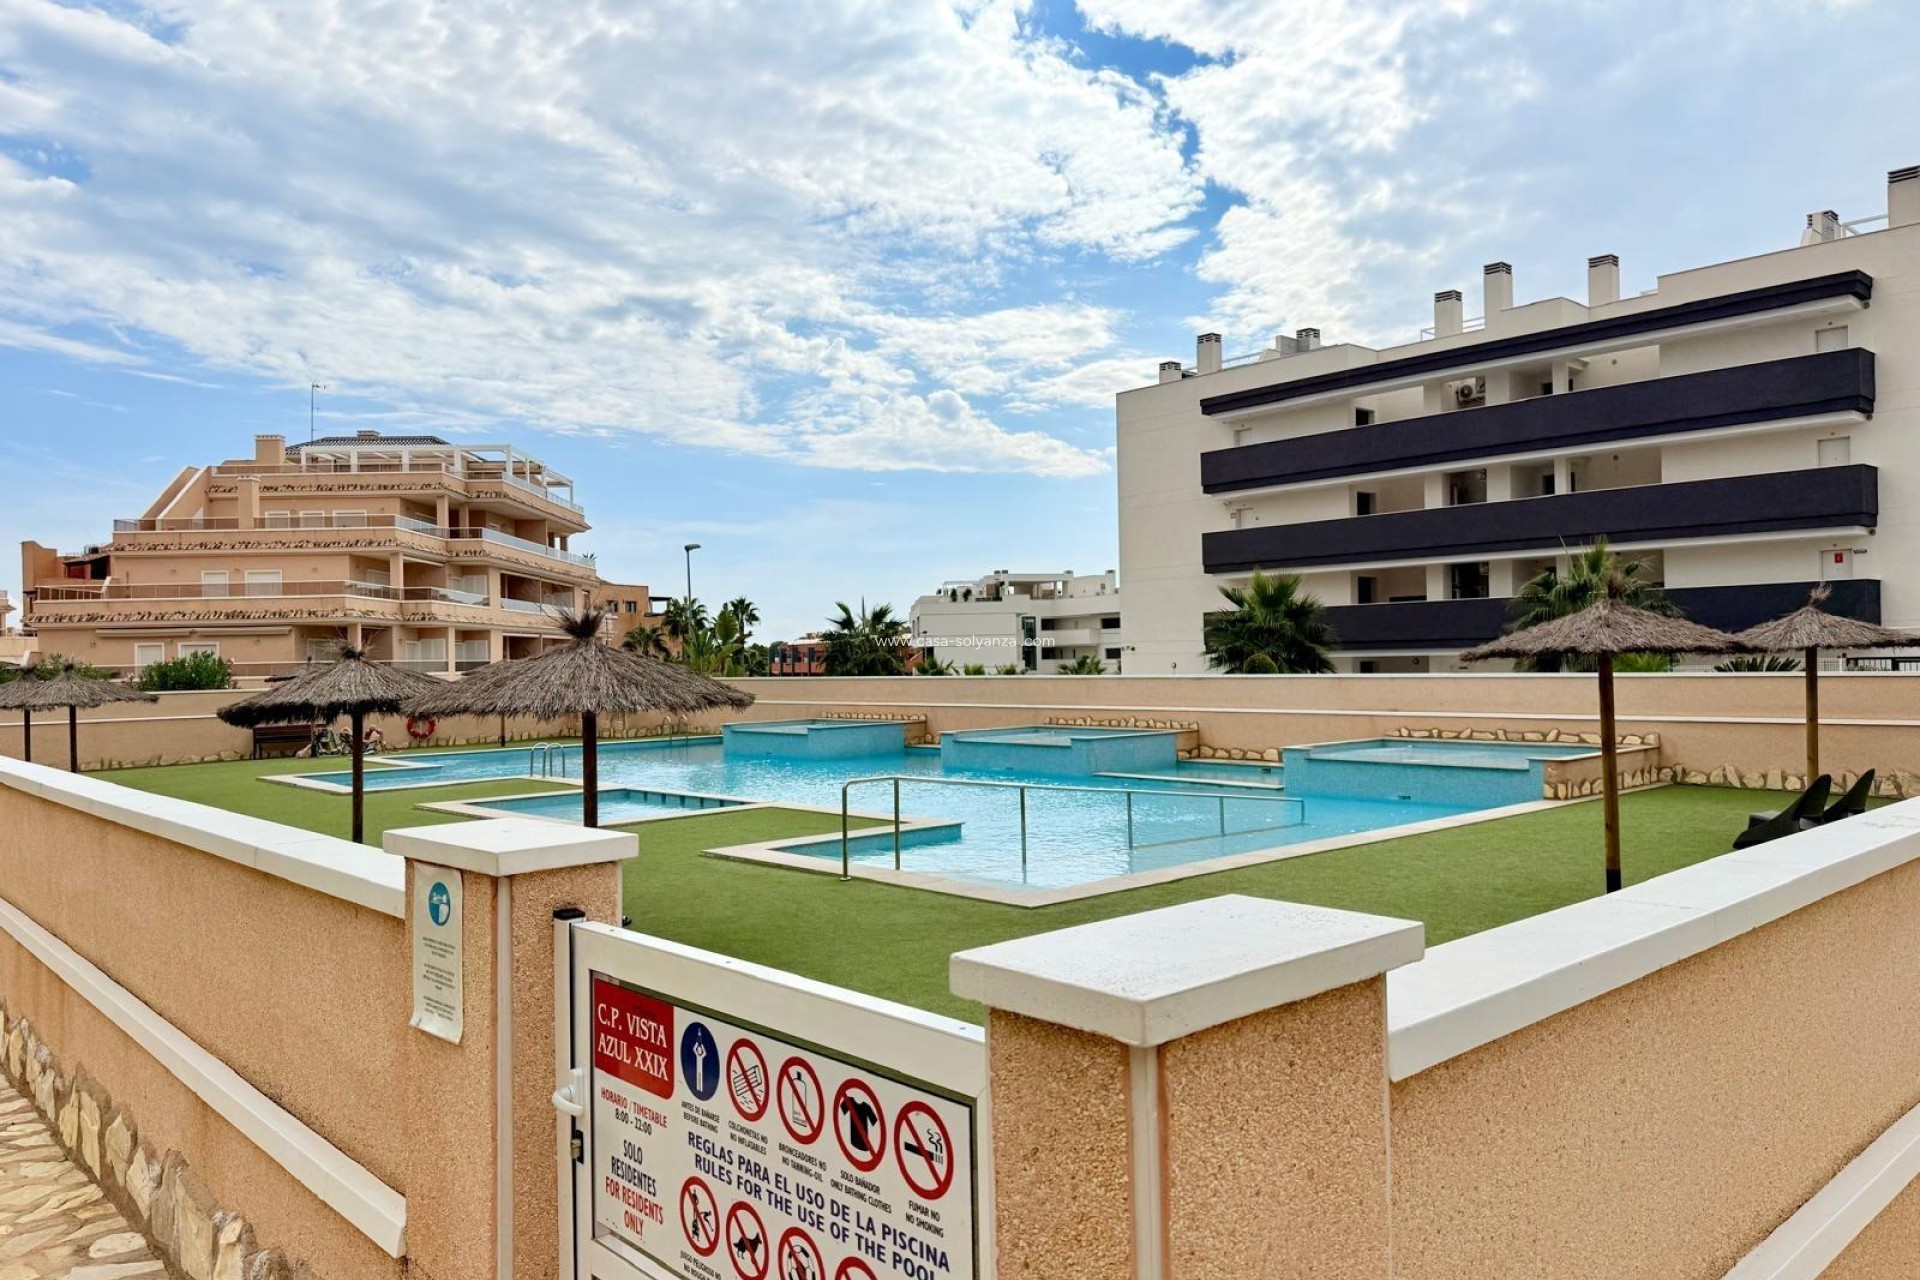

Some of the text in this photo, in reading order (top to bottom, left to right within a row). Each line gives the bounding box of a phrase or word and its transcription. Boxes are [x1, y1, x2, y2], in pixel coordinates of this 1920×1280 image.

[598, 1003, 667, 1048] C.P. VISTA
[598, 1033, 669, 1081] AZUL XXIX
[600, 1086, 628, 1109] HORARIO
[633, 1101, 667, 1128] TIMETABLE
[615, 1107, 629, 1125] 8:00
[681, 1100, 694, 1112] ANTES
[695, 1105, 701, 1114] DE
[683, 1111, 719, 1134] BEFORE BATHING
[728, 1120, 769, 1145] COLCHONETAS NO
[623, 1139, 643, 1165] SOLO
[730, 1132, 767, 1156] NO INFLATABLES
[779, 1142, 827, 1171] BRONCEADORES NO
[782, 1156, 789, 1166] NO
[611, 1155, 656, 1197] RESIDENTES
[840, 1170, 853, 1183] SOLO
[605, 1175, 663, 1225] FOR RESIDENTS
[688, 1131, 950, 1273] REGLAS PARA EL USO DE LA PISCINA
[695, 1153, 732, 1186] RULES
[737, 1174, 762, 1201] FOR
[766, 1189, 792, 1216] THE
[798, 1205, 825, 1232] USE
[830, 1221, 849, 1243] OF
[855, 1233, 886, 1264] THE
[830, 1179, 892, 1214] ONLY BATHING CLOTHES
[624, 1210, 644, 1237] ONLY
[908, 1200, 940, 1222] FUMAR NO
[905, 1212, 944, 1238] NO SMOKING
